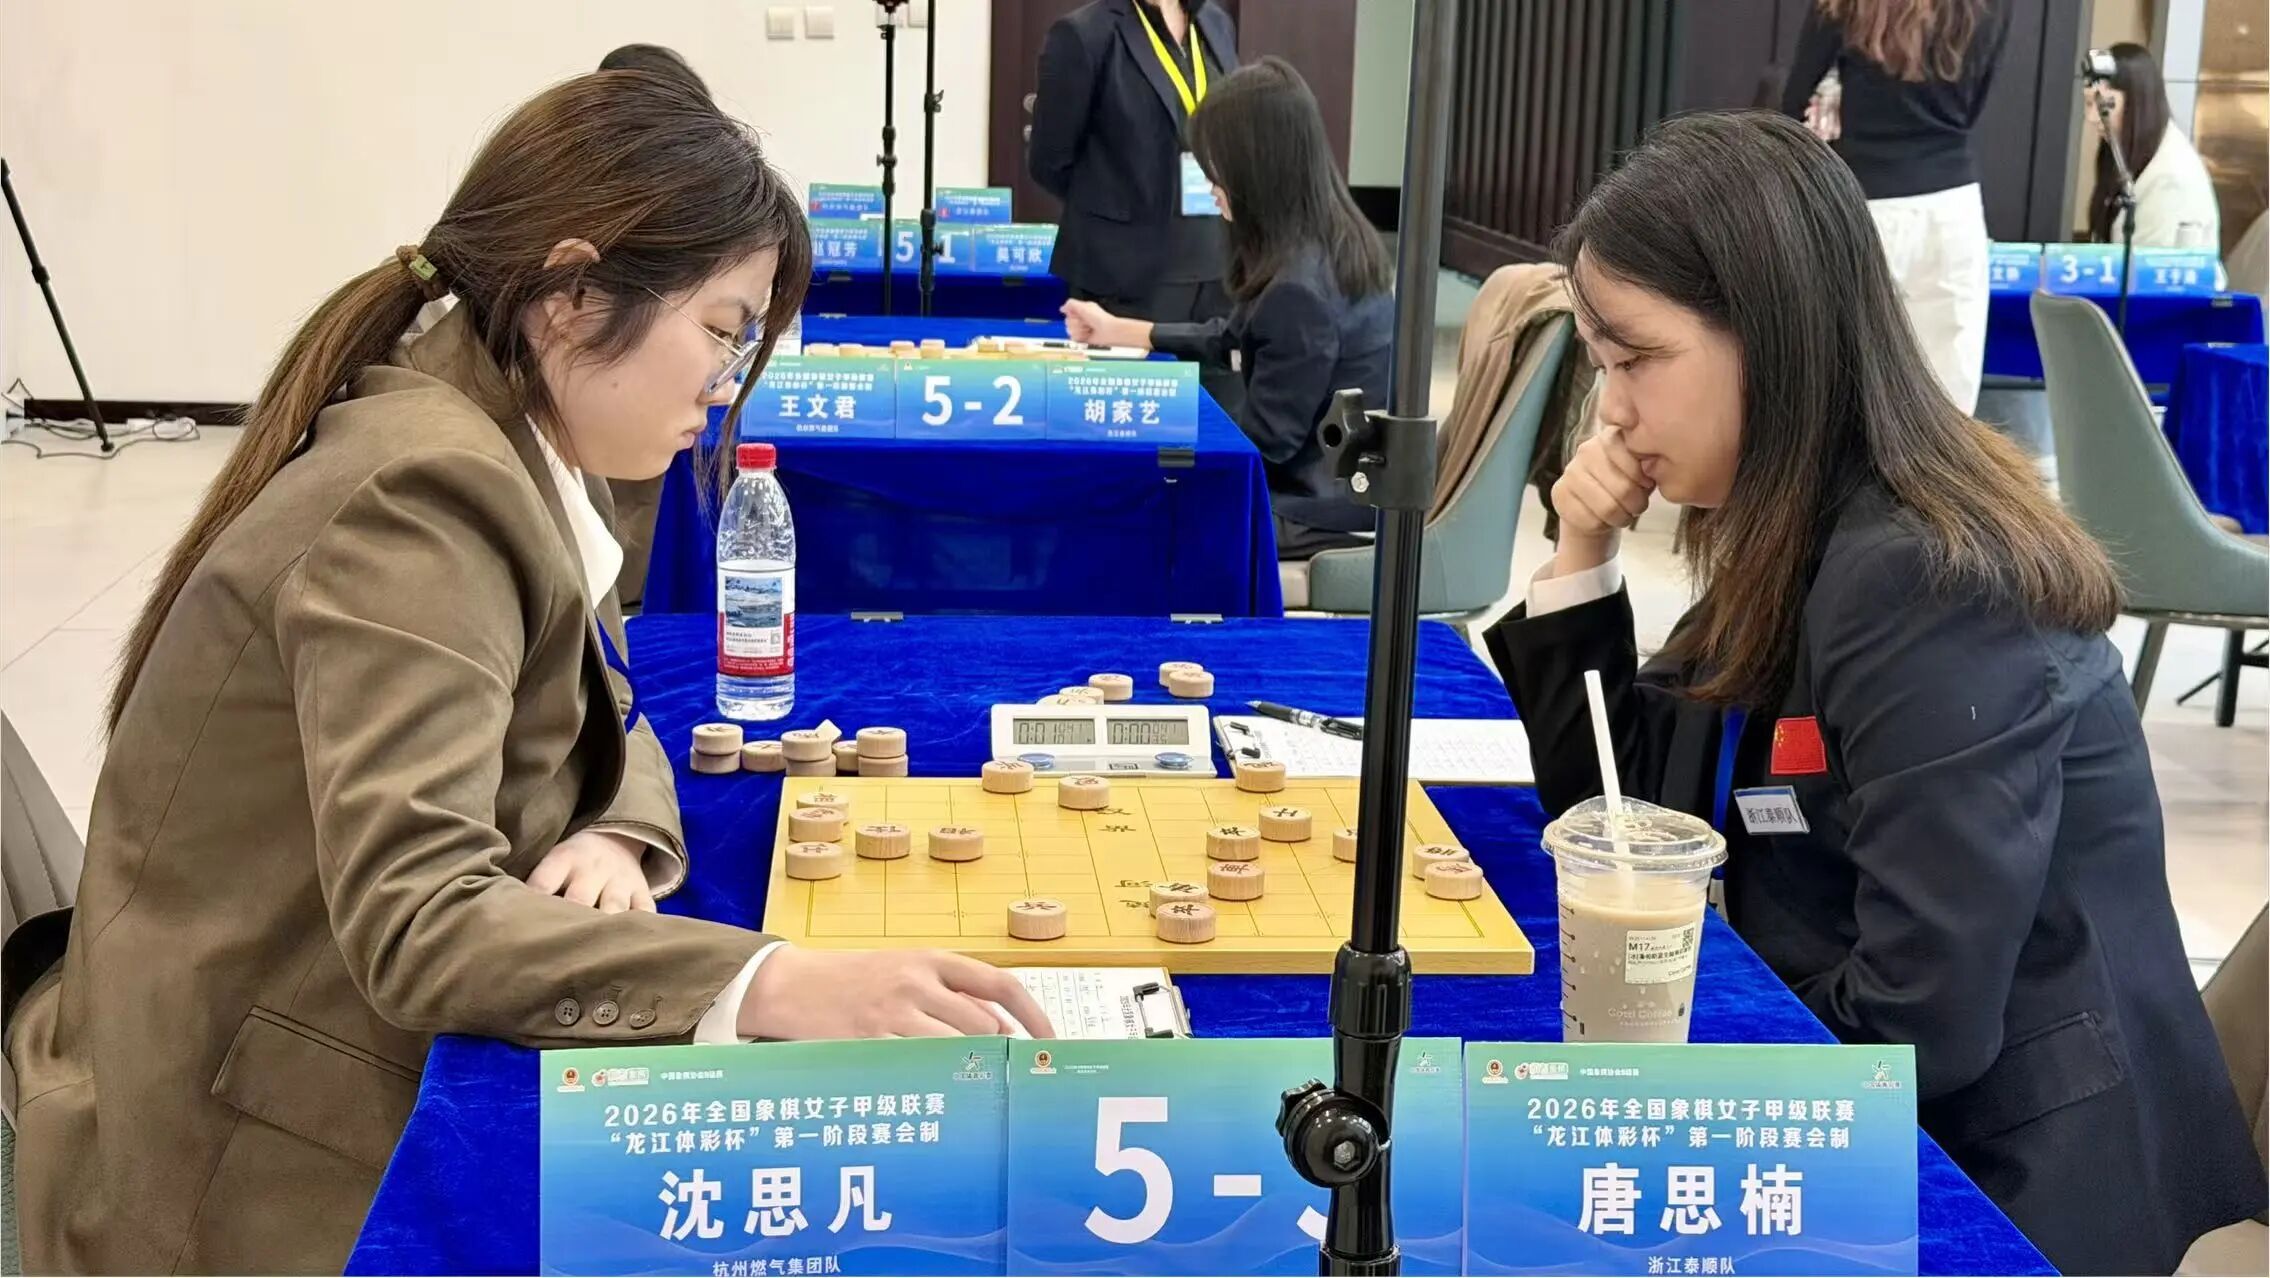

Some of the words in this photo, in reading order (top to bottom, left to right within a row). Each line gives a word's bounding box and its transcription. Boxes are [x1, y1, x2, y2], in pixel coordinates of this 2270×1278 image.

[2060, 254, 2116, 284] 3-1
[779, 394, 857, 420] 王文君
[1084, 399, 1160, 425] 胡家艺
[1628, 942, 1650, 952] M17
[604, 1094, 945, 1128] 2026年全国象棋女子甲级联赛
[1527, 1097, 1856, 1122] 2026年全国象棋女子甲级联赛
[658, 1165, 893, 1241] 沈思凡
[1577, 1162, 1804, 1236] 唐思楠
[713, 1256, 841, 1277] 杭州燃气集团队
[1647, 1256, 1736, 1276] 浙江泰顺队
